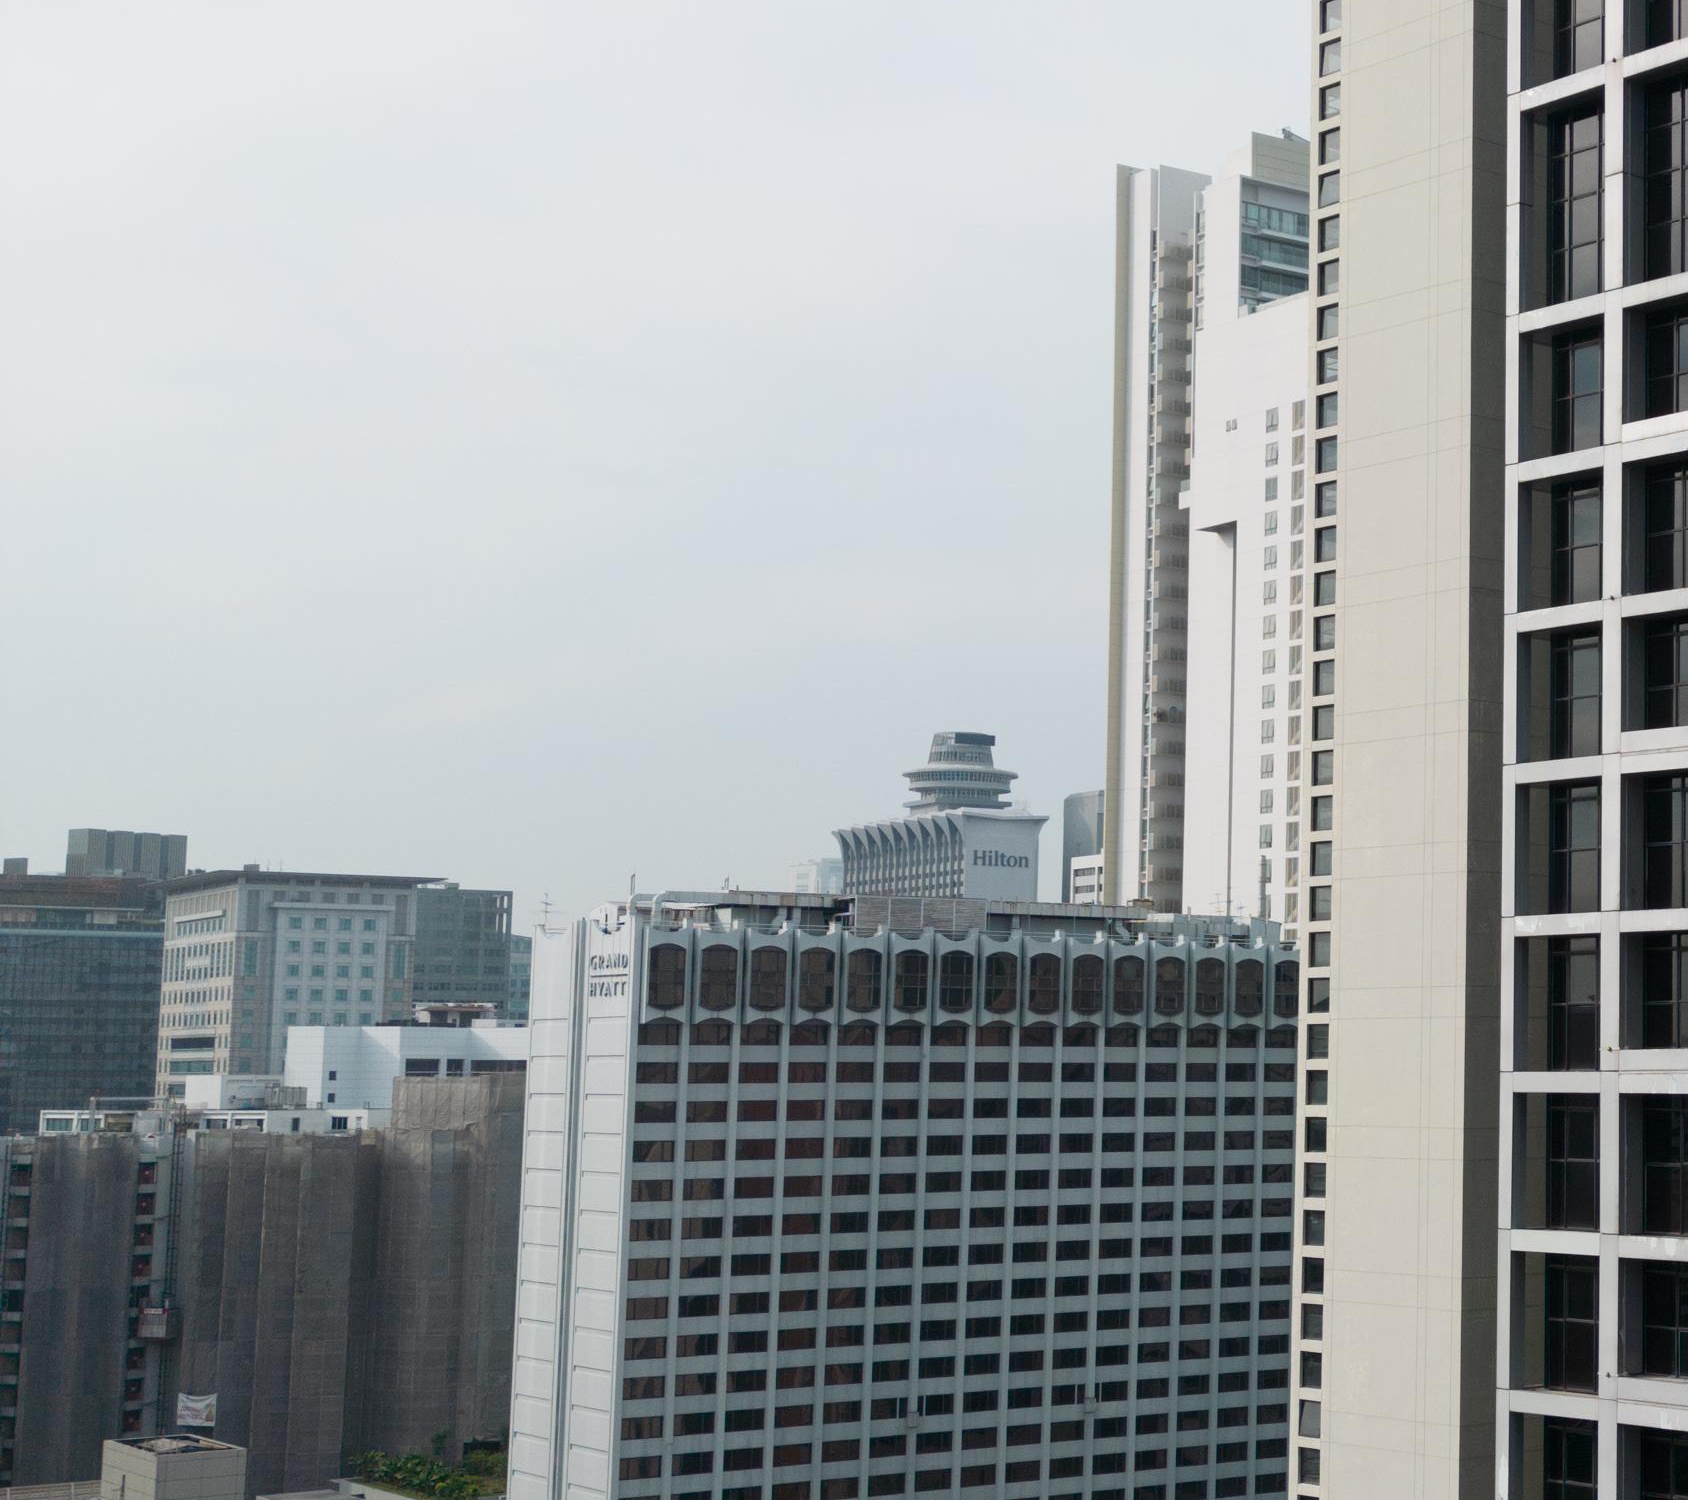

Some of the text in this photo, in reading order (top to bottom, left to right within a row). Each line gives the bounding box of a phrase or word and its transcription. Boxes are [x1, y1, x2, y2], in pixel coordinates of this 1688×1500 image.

[973, 849, 1029, 868] Hilton
[590, 953, 629, 970] GRAND
[590, 981, 627, 997] HYATT
